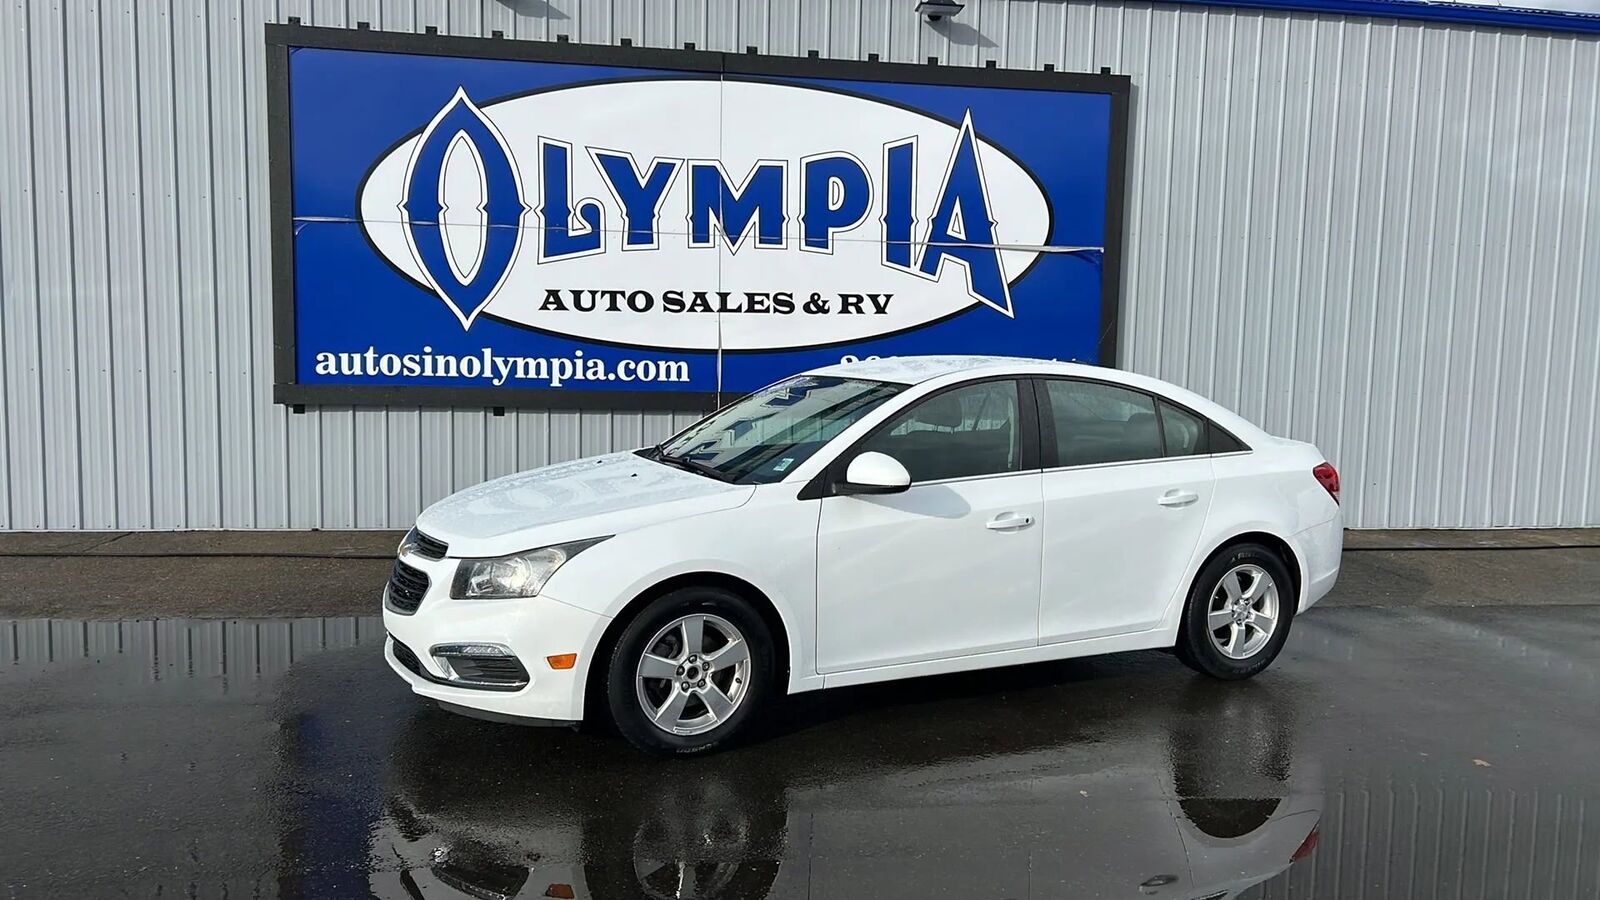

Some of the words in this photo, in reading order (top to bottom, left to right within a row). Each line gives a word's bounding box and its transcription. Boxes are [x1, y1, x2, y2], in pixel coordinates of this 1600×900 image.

[399, 87, 1014, 330] OLYMPIA
[538, 289, 655, 313] AUTO
[662, 290, 796, 315] SALES
[802, 292, 830, 315] &
[837, 293, 894, 315] RV
[315, 346, 690, 387] autosinolympia.com
